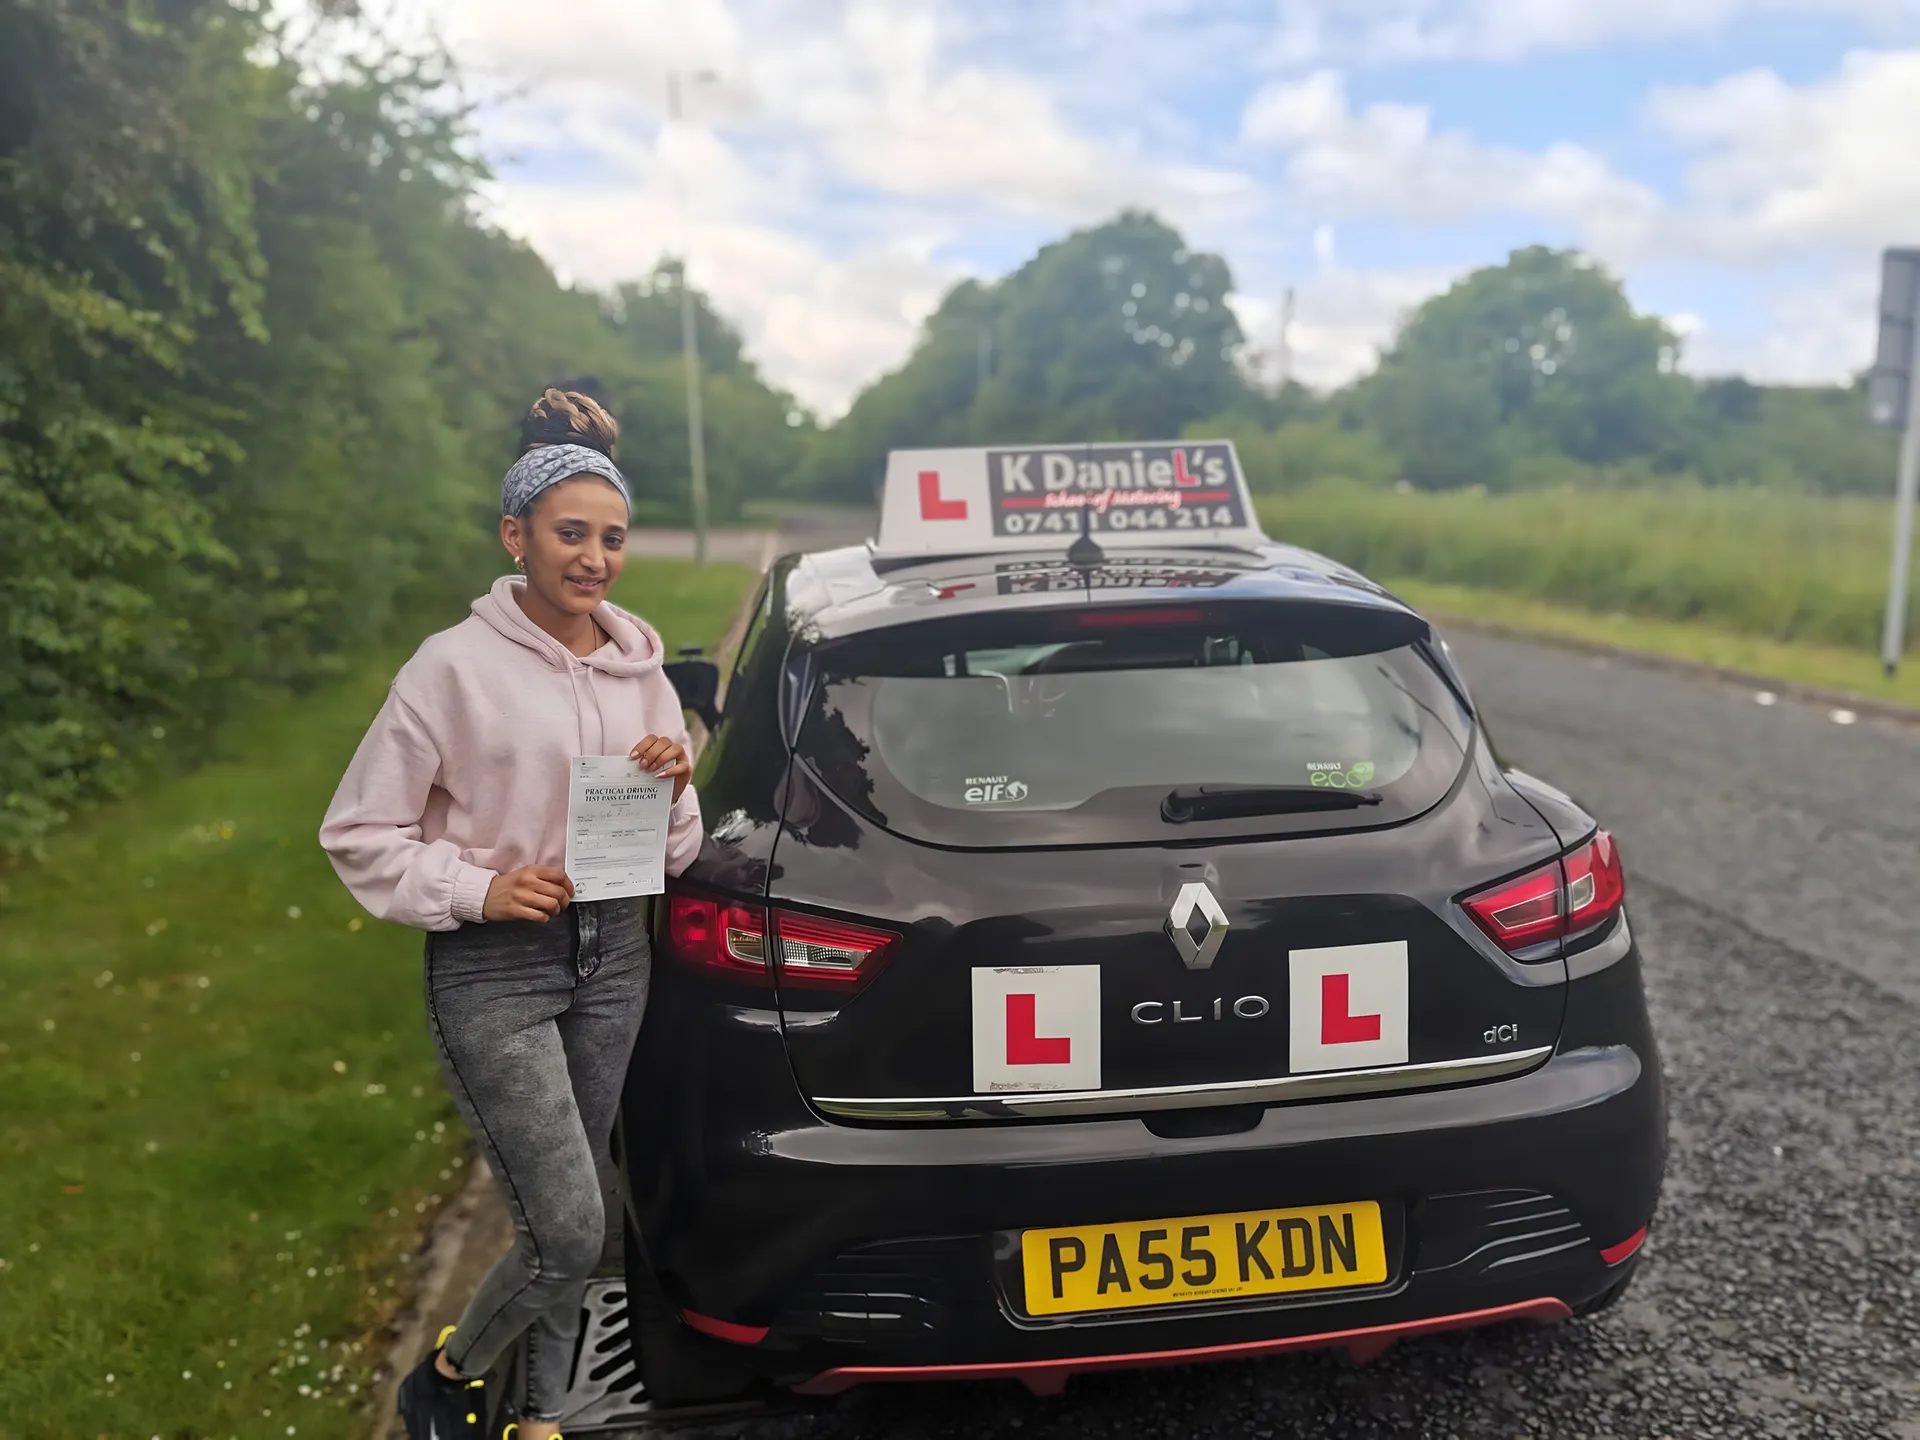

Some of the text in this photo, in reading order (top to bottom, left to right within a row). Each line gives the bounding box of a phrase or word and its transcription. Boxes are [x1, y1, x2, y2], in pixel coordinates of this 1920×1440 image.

[1000, 448, 1228, 492] K DanieL's
[918, 471, 968, 520] L
[1045, 489, 1092, 508] Schoo
[1004, 506, 1233, 534] 07411 044 214
[627, 786, 658, 794] DRIVING
[964, 785, 1004, 802] elf
[965, 776, 1008, 785] RENAULT
[1311, 771, 1364, 788] eco
[1130, 994, 1270, 1026] CLIO
[1320, 974, 1381, 1046] L
[1006, 994, 1071, 1066] L
[1483, 1023, 1518, 1044] dCi
[1048, 1212, 1358, 1299] PA55 KDN
